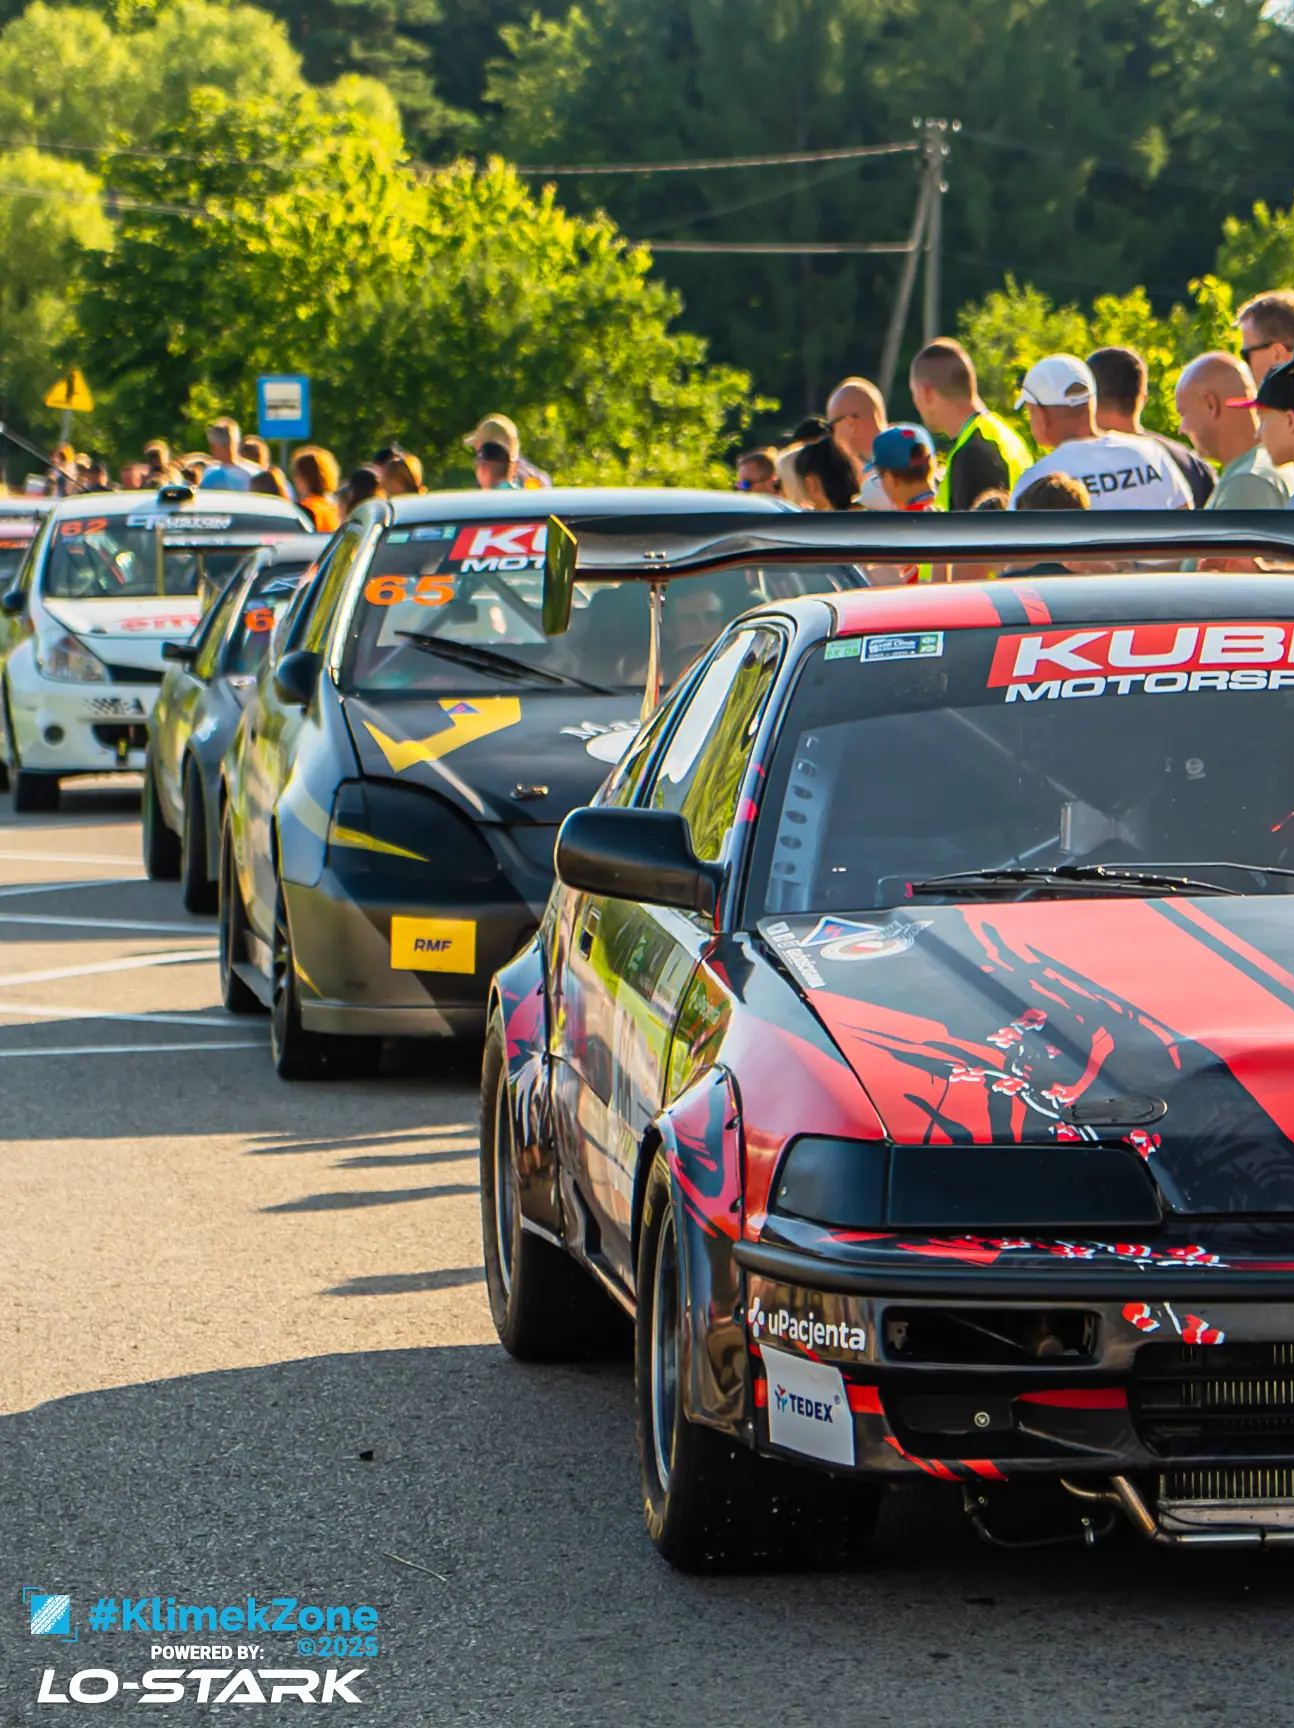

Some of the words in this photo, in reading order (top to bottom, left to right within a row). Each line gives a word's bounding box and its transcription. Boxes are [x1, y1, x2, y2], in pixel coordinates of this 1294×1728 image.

[1080, 465, 1163, 497] ĘDZIA
[61, 518, 107, 536] 62
[364, 575, 454, 607] 65
[414, 938, 452, 952] RMF
[768, 1309, 866, 1351] uPacjenta
[788, 1393, 833, 1424] TEDEX
